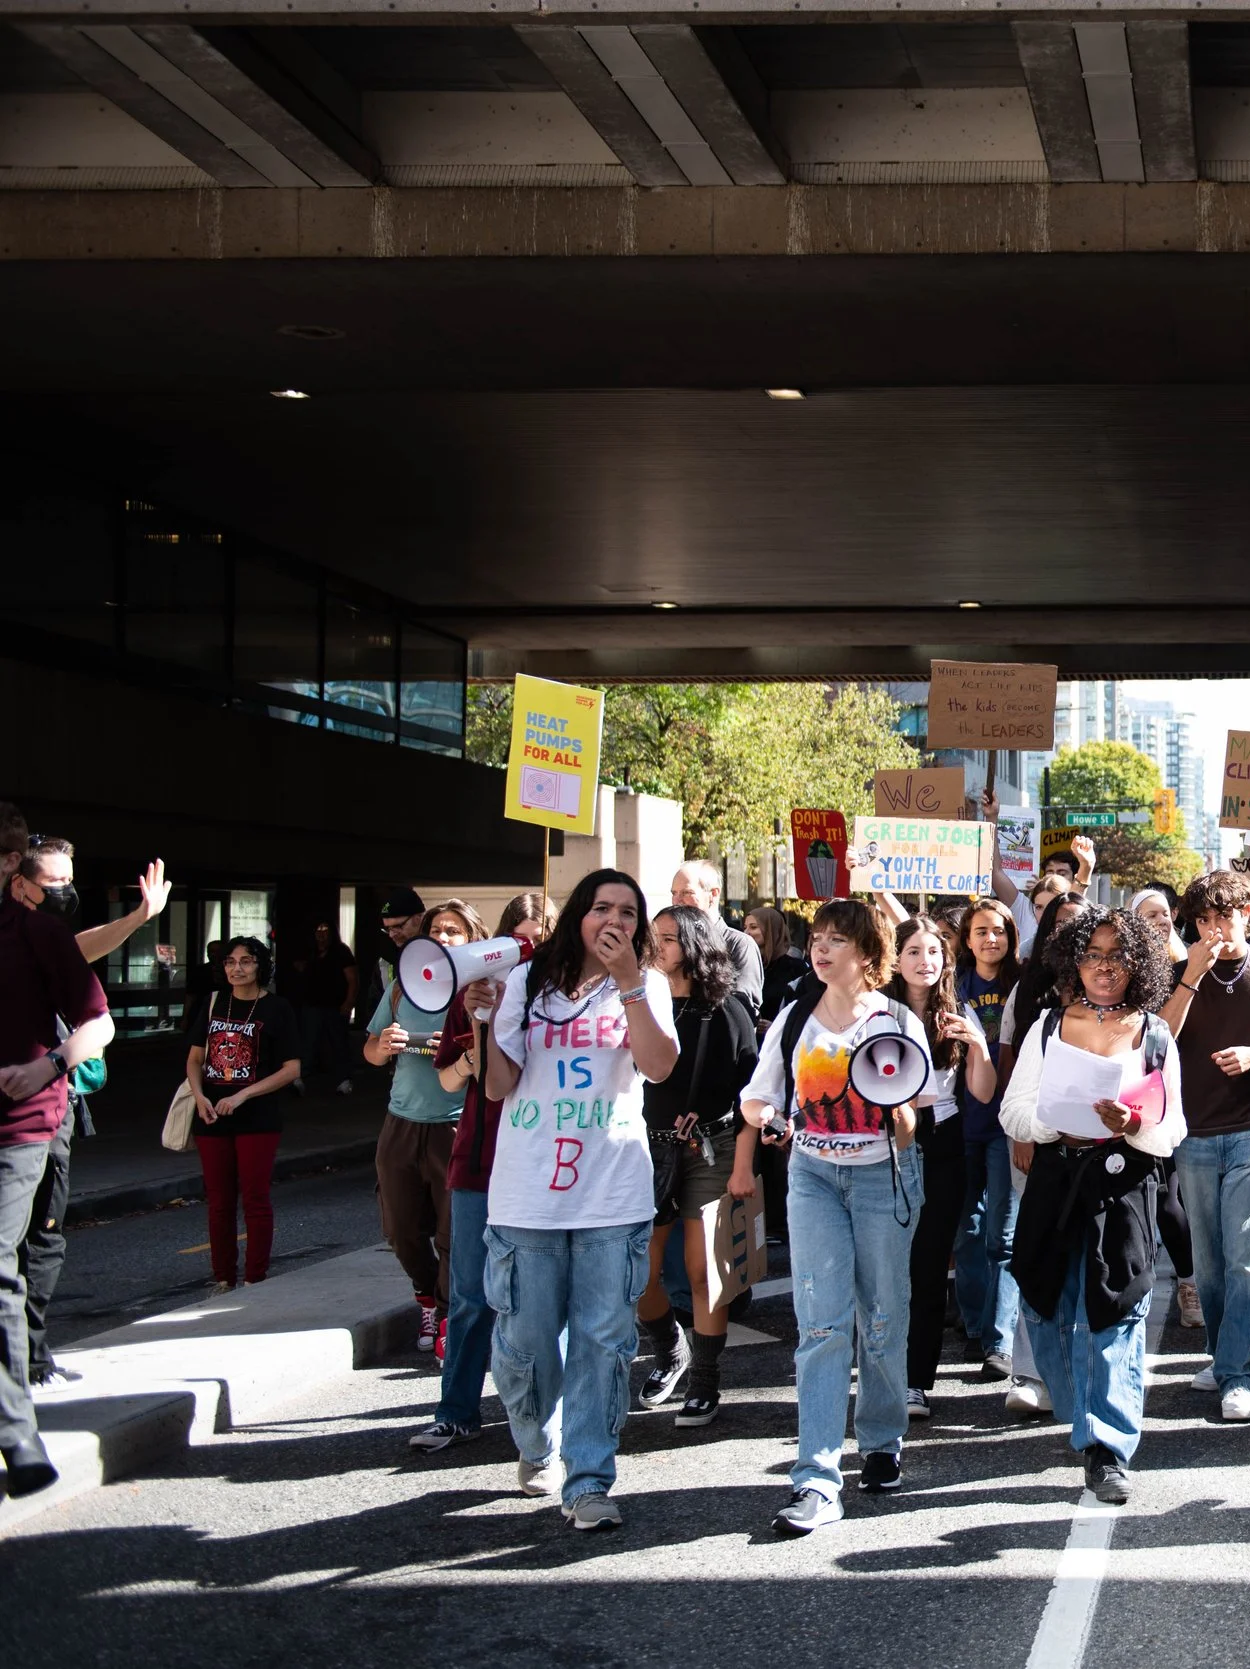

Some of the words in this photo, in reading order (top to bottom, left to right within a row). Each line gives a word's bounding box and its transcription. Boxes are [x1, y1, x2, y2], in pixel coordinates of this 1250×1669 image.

[937, 667, 967, 676] WHEN
[948, 697, 968, 712] the
[976, 697, 997, 712] kids
[526, 711, 568, 733] HEAT
[958, 721, 975, 735] the
[981, 724, 1044, 739] LEADERS
[525, 728, 583, 753] PUMPS
[523, 745, 550, 762] FOR
[553, 752, 582, 768] ALL
[880, 774, 942, 812] We
[1222, 796, 1239, 818] IN
[794, 811, 830, 827] DONT
[1073, 815, 1097, 824] Howe
[1100, 815, 1109, 824] St
[825, 827, 843, 841] IT!
[863, 823, 931, 842] GREEN
[935, 826, 985, 848] JOBS
[891, 842, 924, 856] FOR
[927, 843, 958, 857] ALL
[879, 856, 937, 874] YOUTH
[871, 873, 944, 890] CLIMATE
[947, 874, 991, 892] CORPS
[483, 951, 502, 962] PYLE
[979, 994, 999, 1006] FOR
[557, 1056, 593, 1089] IS
[549, 1137, 583, 1191] B
